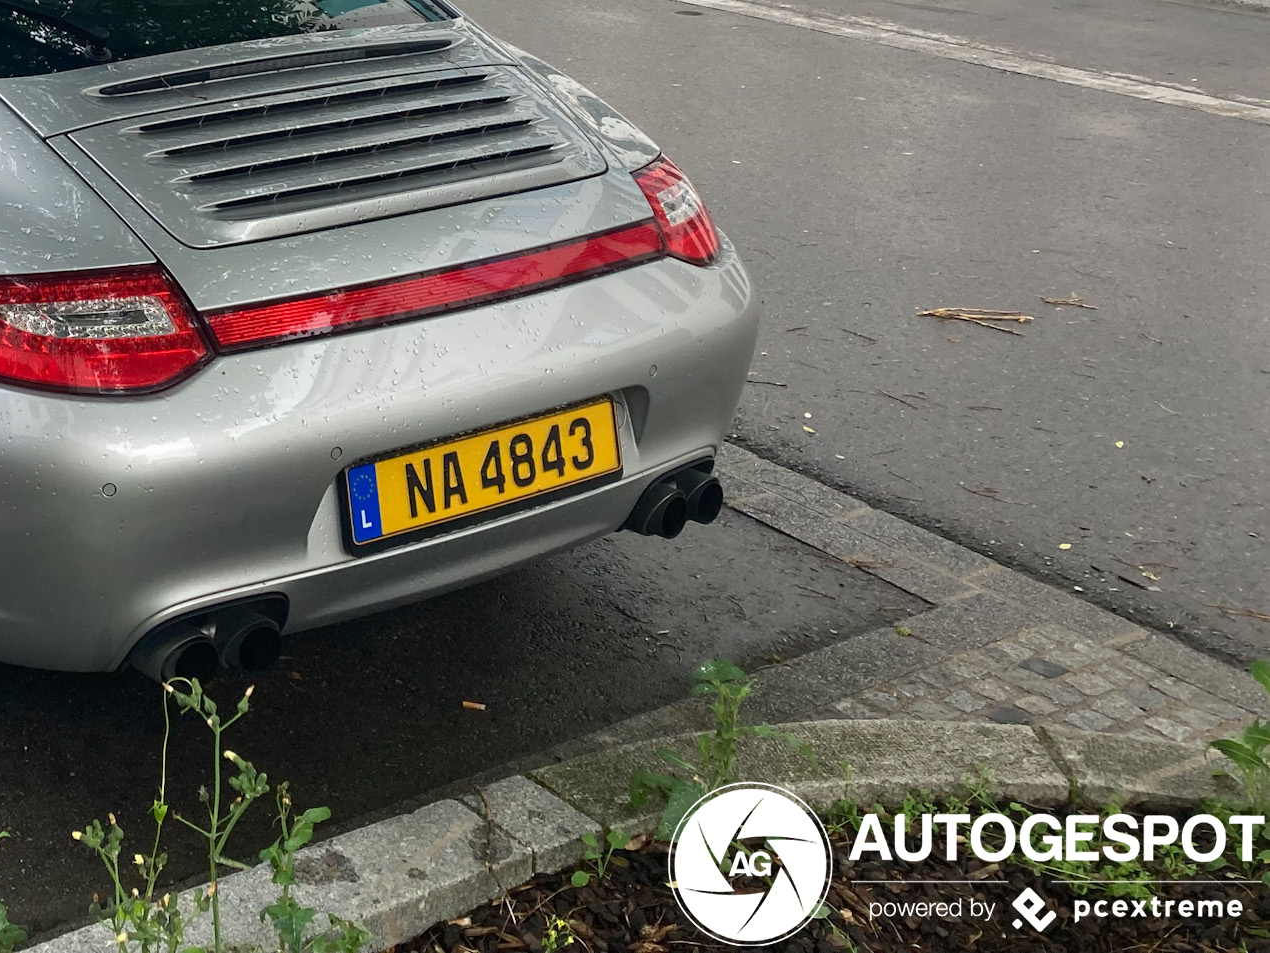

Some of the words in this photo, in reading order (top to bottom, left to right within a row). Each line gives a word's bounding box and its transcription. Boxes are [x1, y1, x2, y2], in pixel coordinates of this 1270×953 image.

[360, 509, 373, 529] L
[405, 451, 469, 518] NA
[480, 417, 595, 494] 4843
